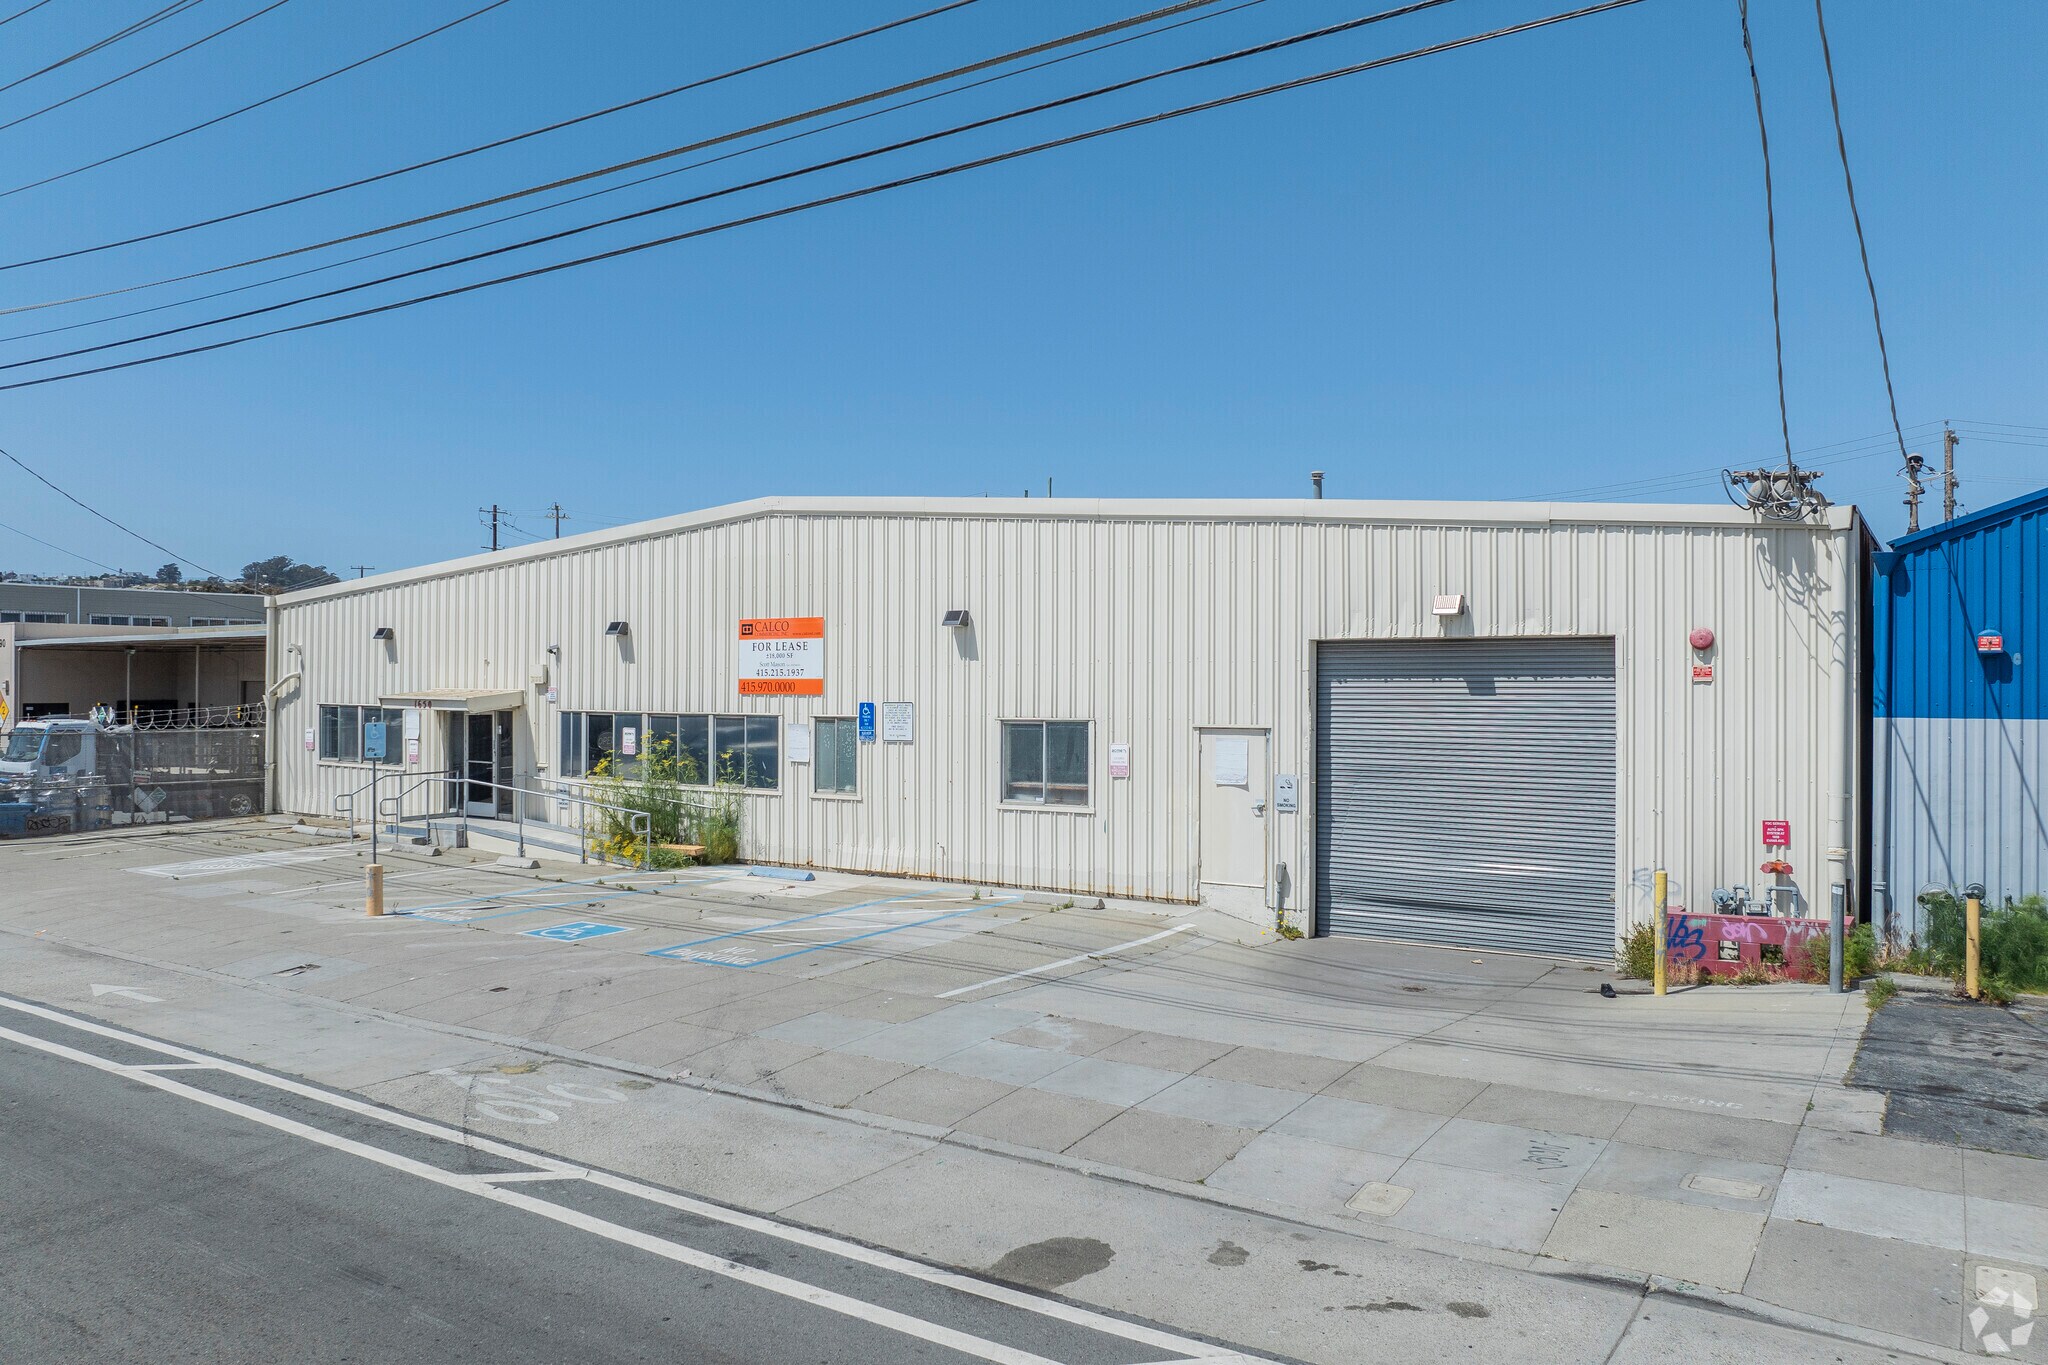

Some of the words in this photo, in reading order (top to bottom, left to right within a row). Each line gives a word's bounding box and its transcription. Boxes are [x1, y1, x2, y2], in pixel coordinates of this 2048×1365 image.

[754, 621, 790, 633] CALCO
[752, 642, 772, 652] FOR
[775, 641, 809, 651] LEASE
[756, 669, 805, 677] 415.215.1937
[741, 681, 796, 692] 415.970.0000
[718, 946, 756, 955] NO
[664, 948, 758, 965] PARKING
